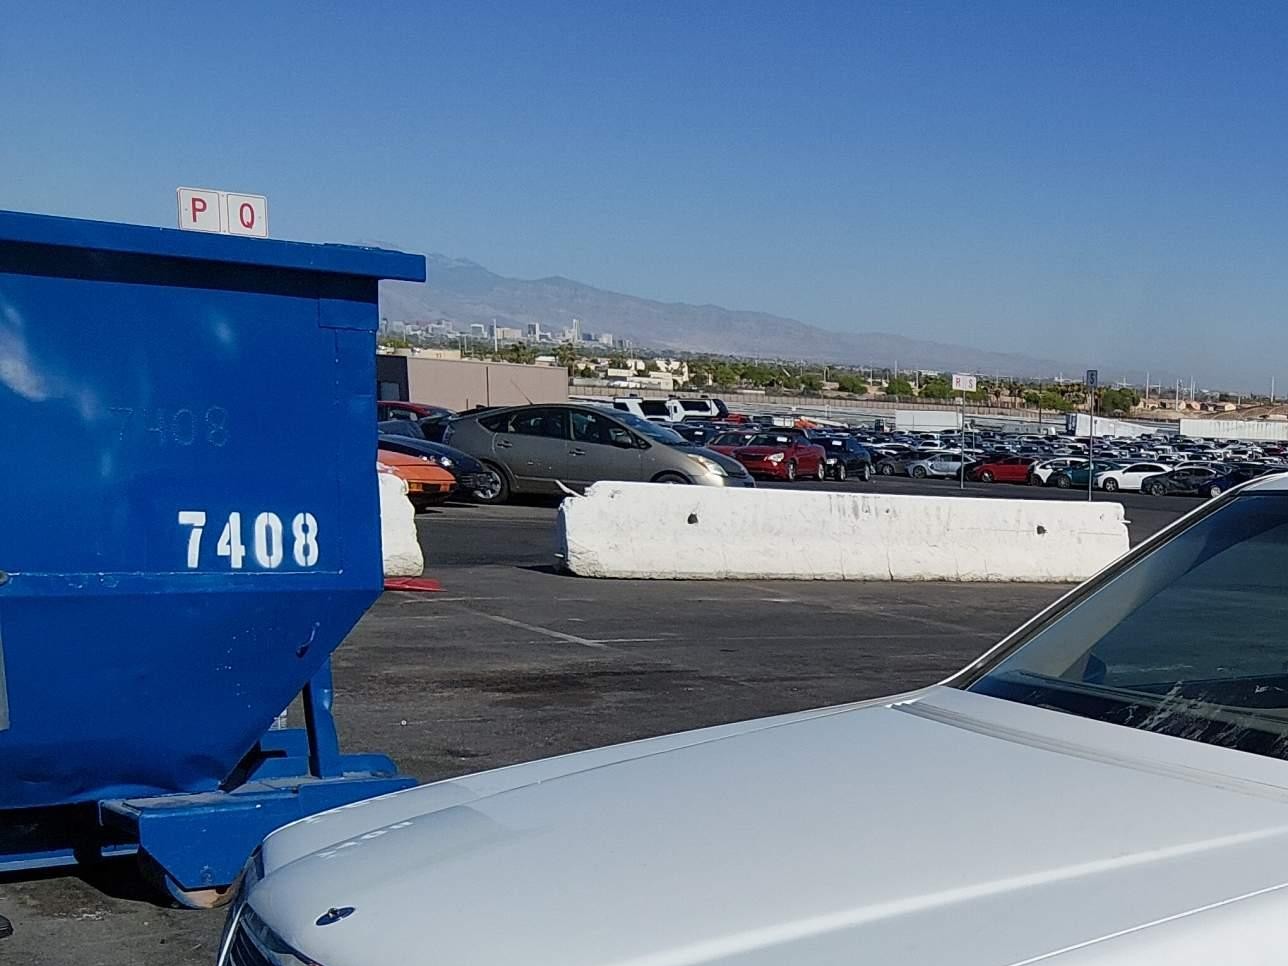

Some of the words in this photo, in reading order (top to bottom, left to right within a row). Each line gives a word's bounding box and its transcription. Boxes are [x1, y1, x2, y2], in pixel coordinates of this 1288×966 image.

[191, 197, 207, 223] P
[240, 203, 254, 229] Q
[178, 511, 319, 569] 7408
